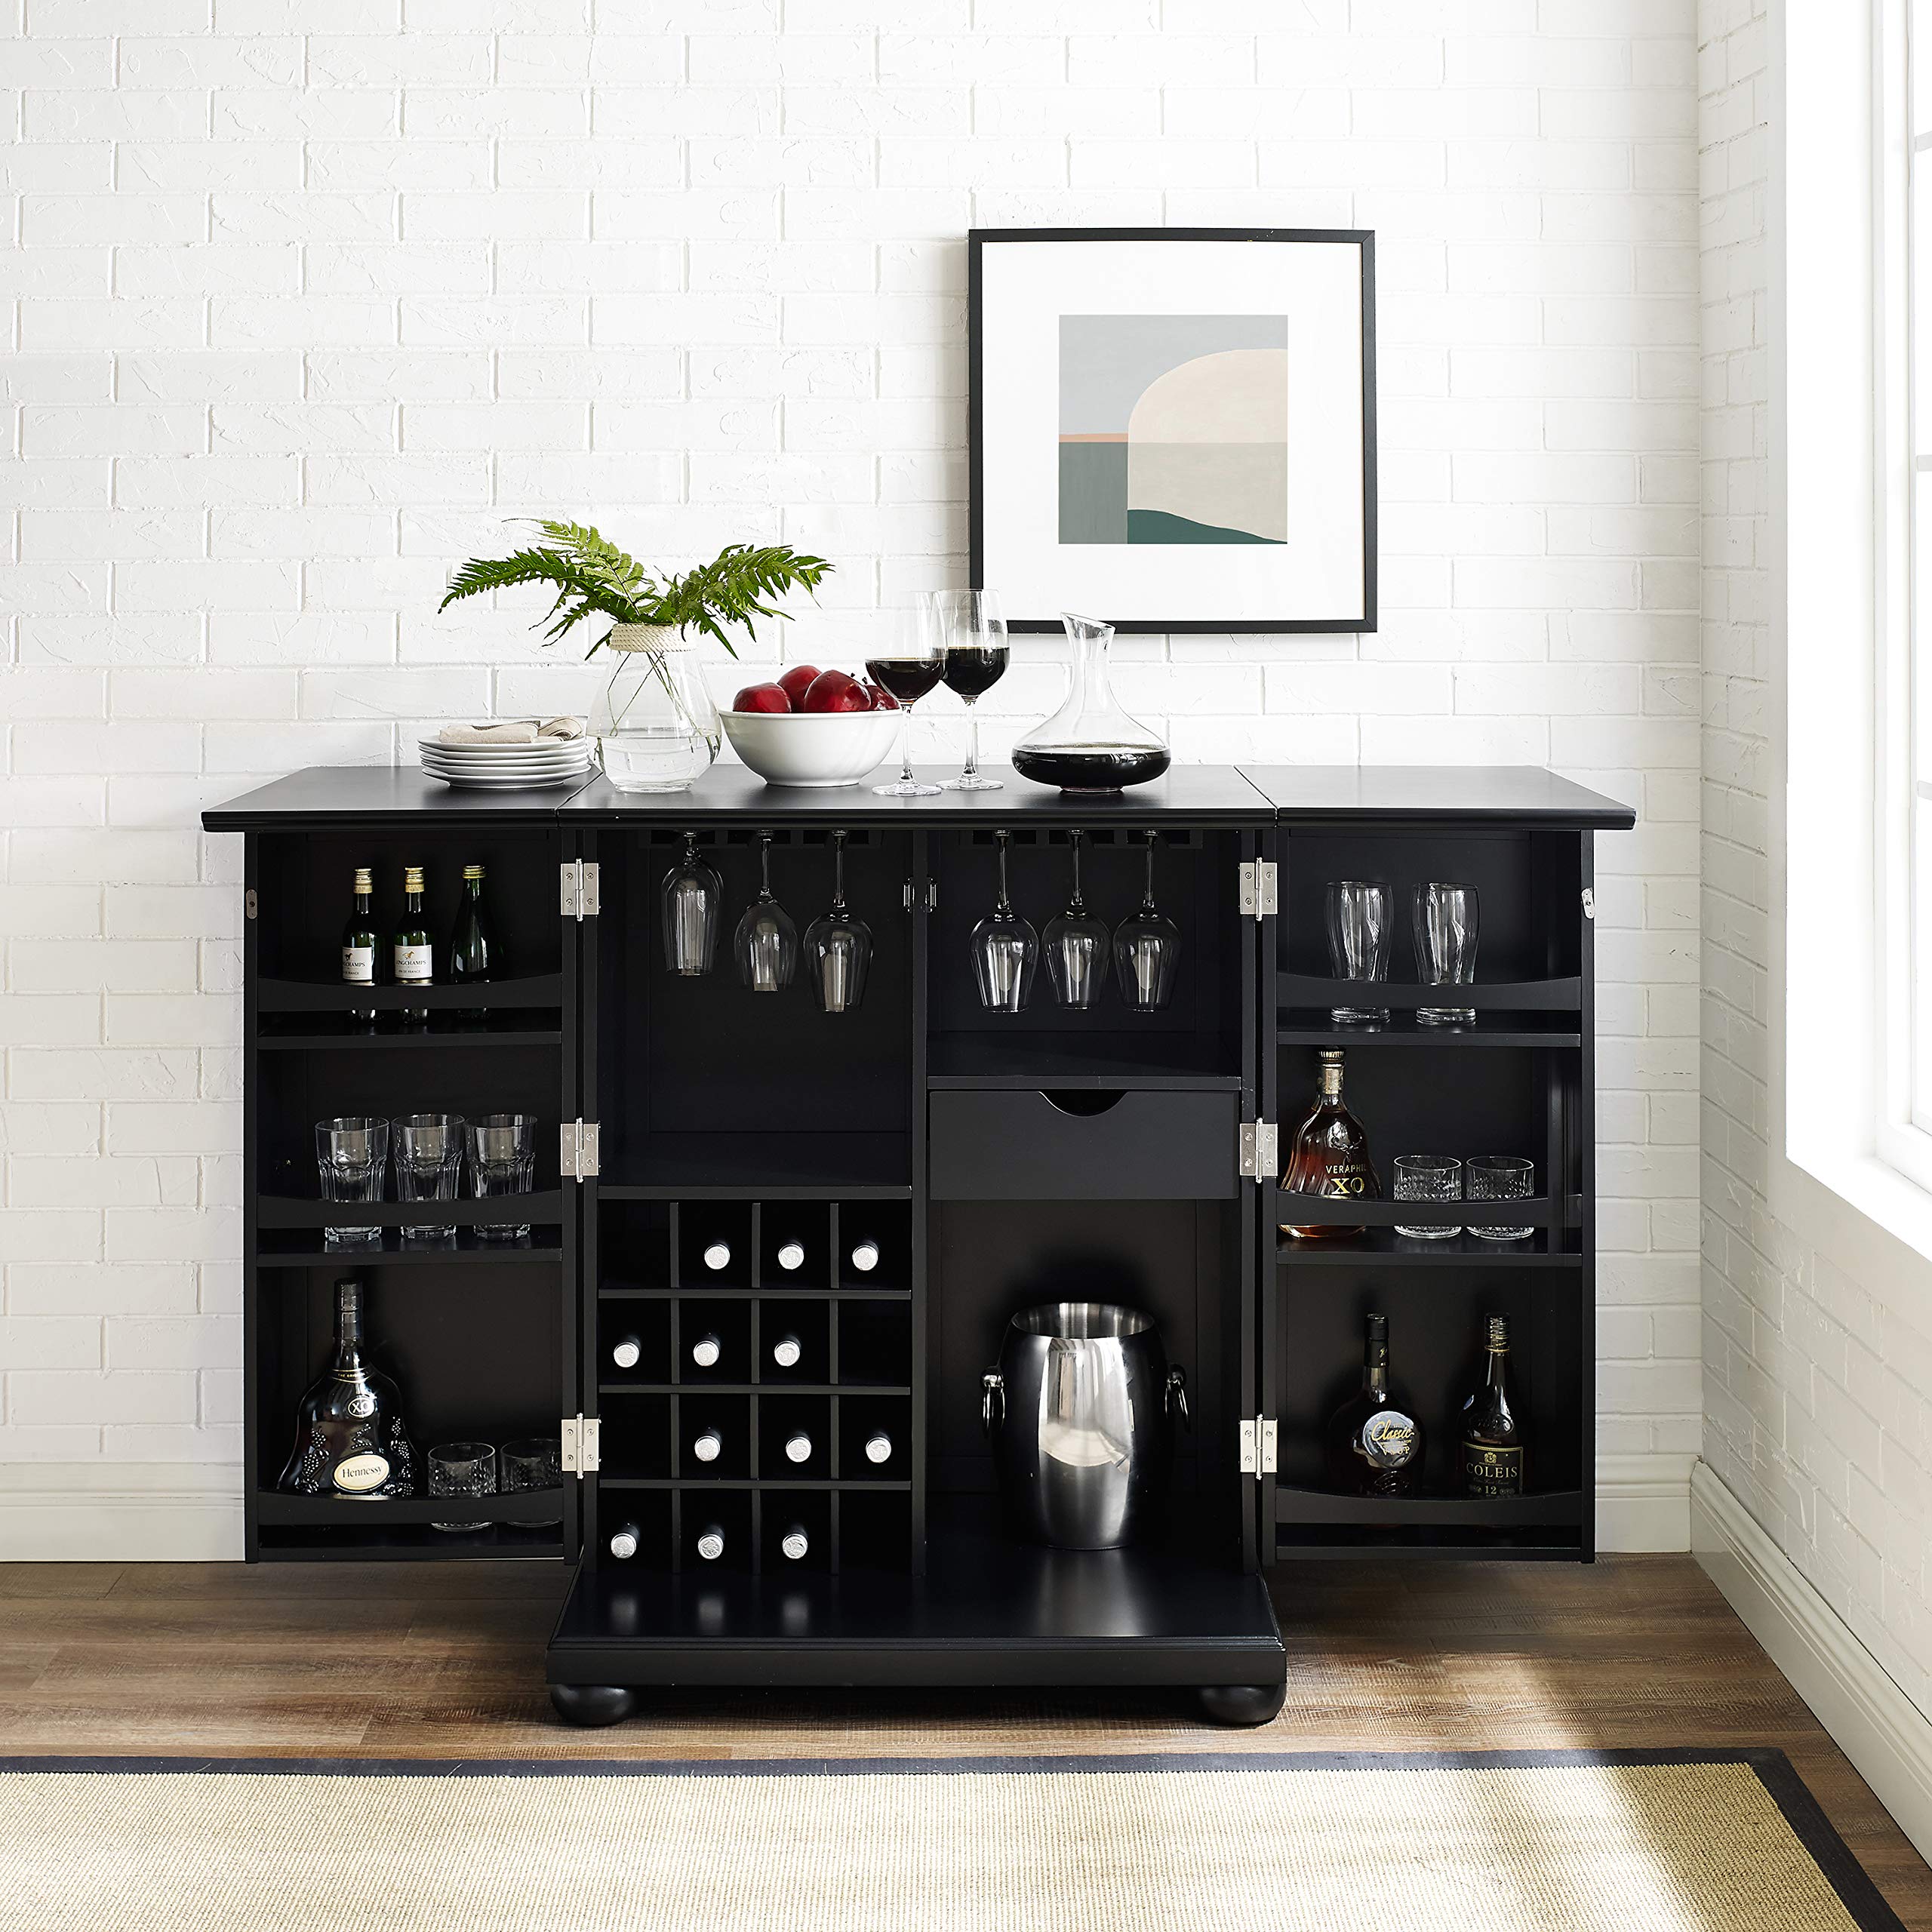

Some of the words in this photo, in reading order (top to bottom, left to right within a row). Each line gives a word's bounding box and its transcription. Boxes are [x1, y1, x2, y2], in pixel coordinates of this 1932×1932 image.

[1331, 1177, 1365, 1195] XO
[351, 1401, 370, 1414] XO
[1371, 1419, 1415, 1441] Classic
[342, 1466, 382, 1478] Hennessy
[1466, 1462, 1518, 1478] COLEIS
[1484, 1485, 1497, 1494] 12
